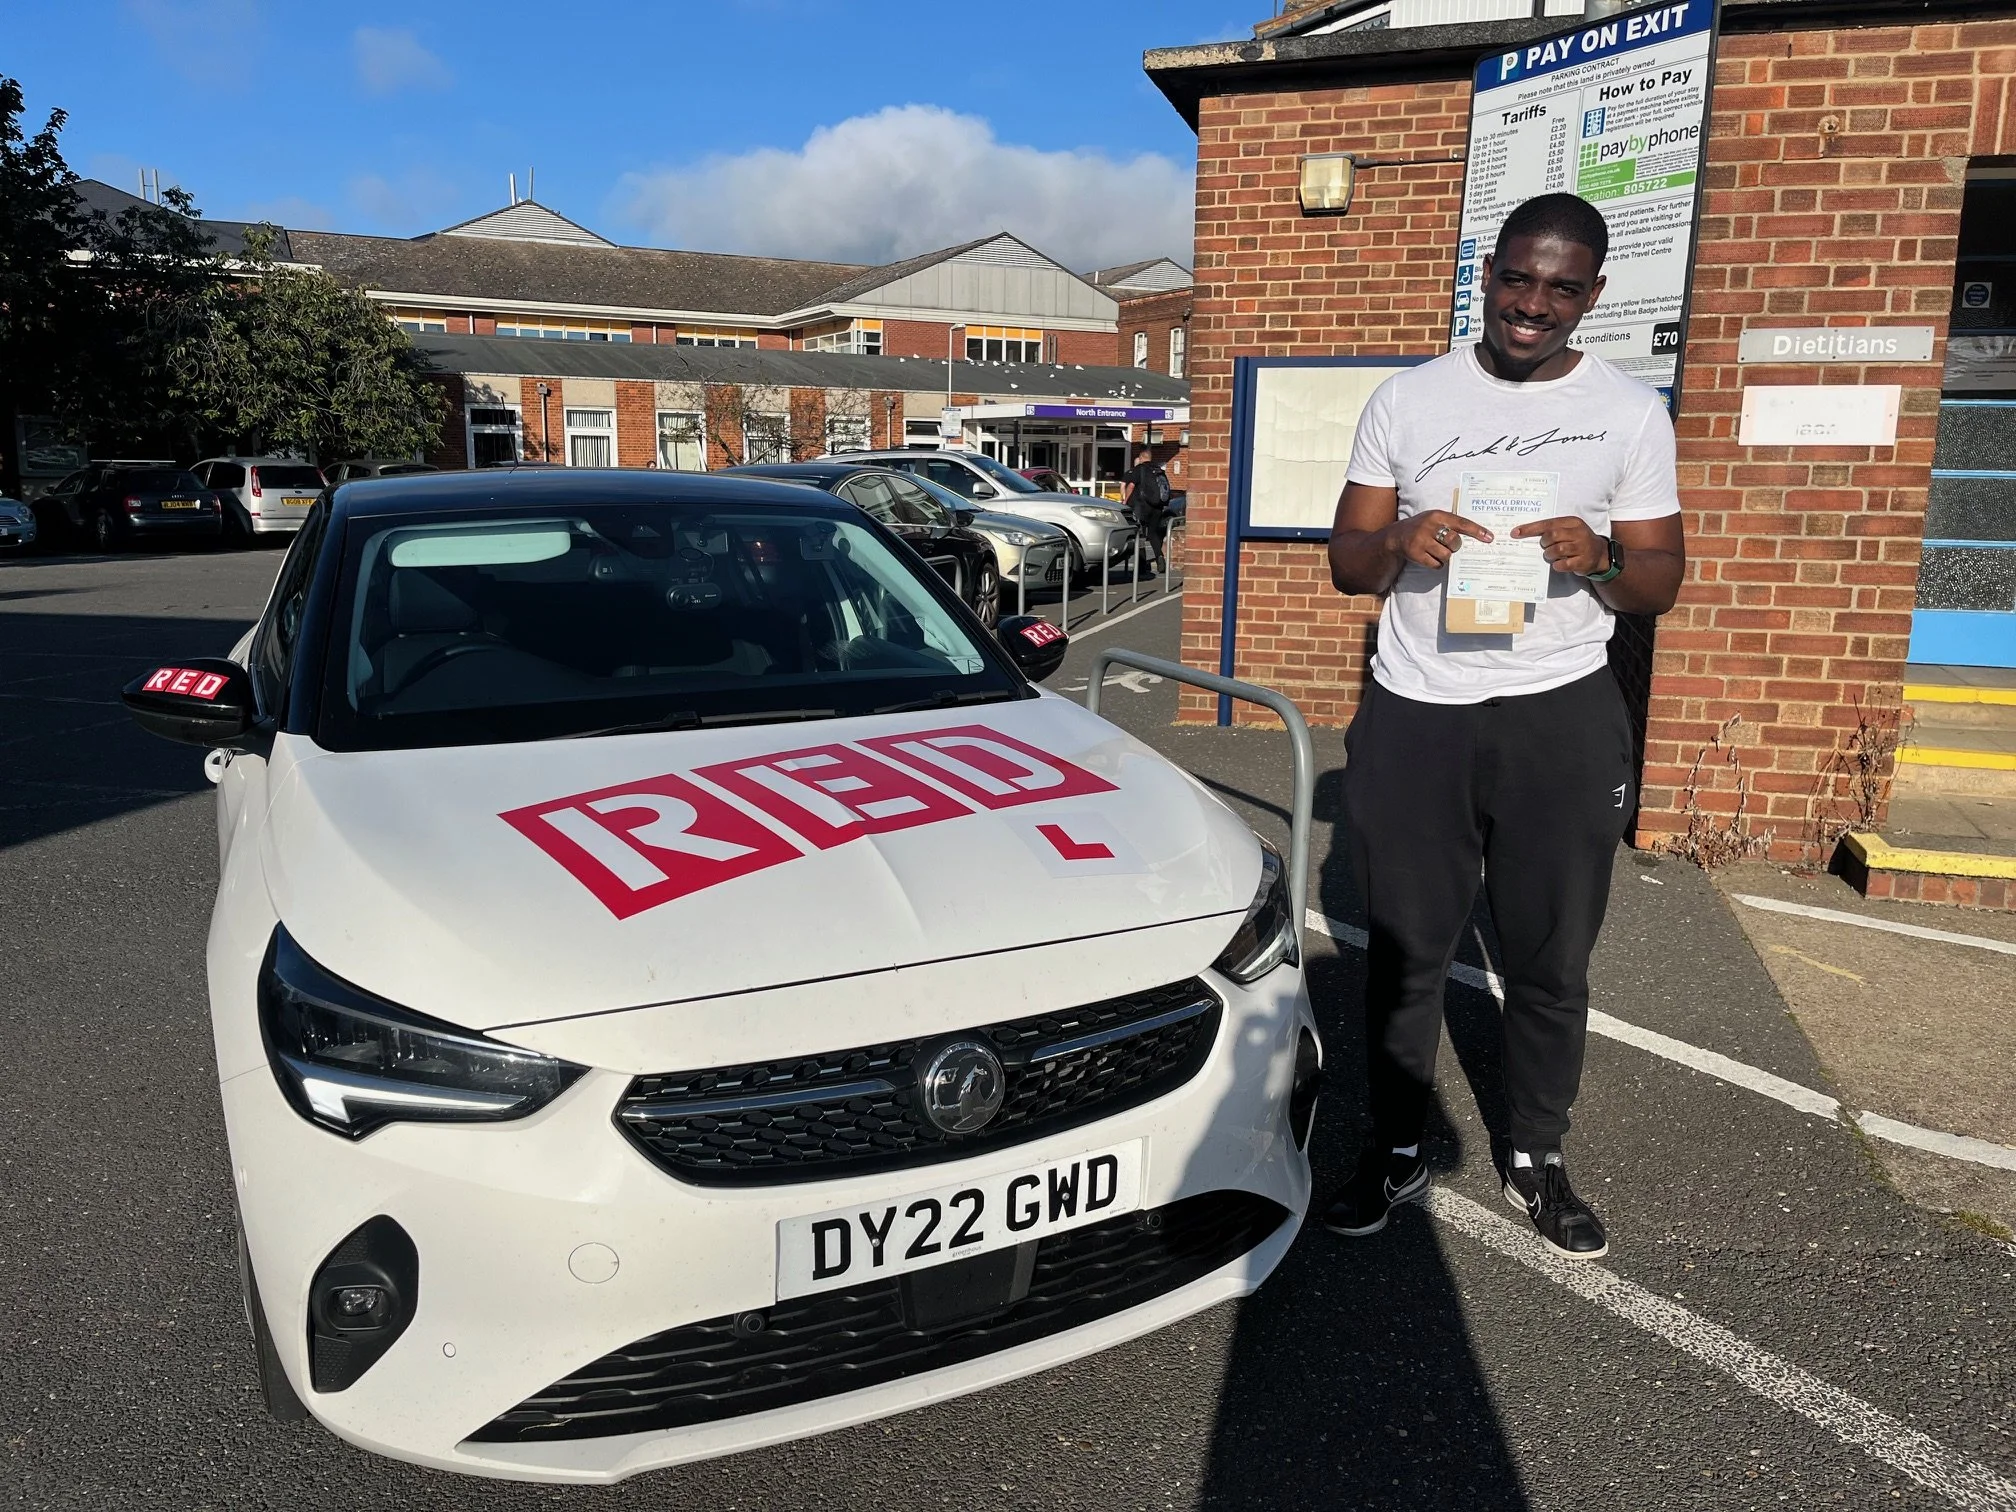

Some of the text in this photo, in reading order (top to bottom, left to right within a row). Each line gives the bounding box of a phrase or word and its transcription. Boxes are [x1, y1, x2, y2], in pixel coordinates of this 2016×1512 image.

[1526, 35, 1575, 69] PAY
[1581, 23, 1618, 53] ON
[1626, 3, 1689, 41] EXIT
[1551, 57, 1620, 82] PARKING CONTRACT
[1517, 91, 1538, 101] Please
[1538, 87, 1552, 95] note
[1553, 82, 1566, 91] that
[1566, 79, 1579, 88] this
[1580, 74, 1595, 84] land
[1602, 65, 1632, 80] privately
[1632, 58, 1656, 71] owned
[1599, 69, 1692, 102] How to Pay
[1644, 93, 1667, 103] duration
[1674, 89, 1687, 98] your
[1616, 107, 1639, 118] payment
[1639, 102, 1662, 111] machine
[1662, 98, 1680, 106] before
[1681, 93, 1700, 102] exiting
[1624, 114, 1635, 123] park
[1639, 111, 1652, 119] your
[1663, 103, 1683, 113] correct
[1684, 99, 1703, 108] vehicle
[1502, 104, 1546, 126] Tariffs
[1605, 122, 1634, 133] registration
[1652, 112, 1675, 122] required
[1496, 128, 1519, 138] minutes
[1492, 147, 1508, 155] hours
[1493, 139, 1506, 147] hour
[1600, 125, 1699, 162] paybyphone
[1490, 162, 1507, 171] hours
[1491, 155, 1507, 163] hours
[1490, 170, 1506, 178] hours
[1483, 188, 1497, 196] pass
[1484, 180, 1498, 188] pass
[1623, 177, 1668, 195] 805722
[1483, 196, 1496, 204] pass
[1617, 200, 1691, 219] and patients. For further
[1469, 214, 1489, 223] Parking
[1610, 220, 1626, 229] ward
[1626, 220, 1638, 228] you
[1650, 213, 1673, 222] visiting
[1616, 230, 1624, 238] all
[1624, 226, 1651, 236] available
[1618, 236, 1674, 252] provide your valid
[1631, 249, 1650, 258] Travel
[1650, 247, 1672, 256] Centre
[1620, 299, 1640, 309] yellow
[1594, 310, 1622, 319] including
[1638, 307, 1658, 315] Badge
[1575, 335, 1582, 345] &
[1584, 332, 1631, 344] conditions
[1653, 331, 1678, 347] £70
[1773, 335, 1898, 356] Dietitians
[1076, 408, 1095, 417] North
[1097, 409, 1126, 418] Entrance
[1415, 428, 1607, 483] Jack & Jones
[1022, 622, 1064, 645] RED
[145, 669, 226, 697] RED
[522, 730, 1088, 903] RED
[1035, 825, 1114, 860] L
[812, 1154, 1118, 1281] DY22 GWD
